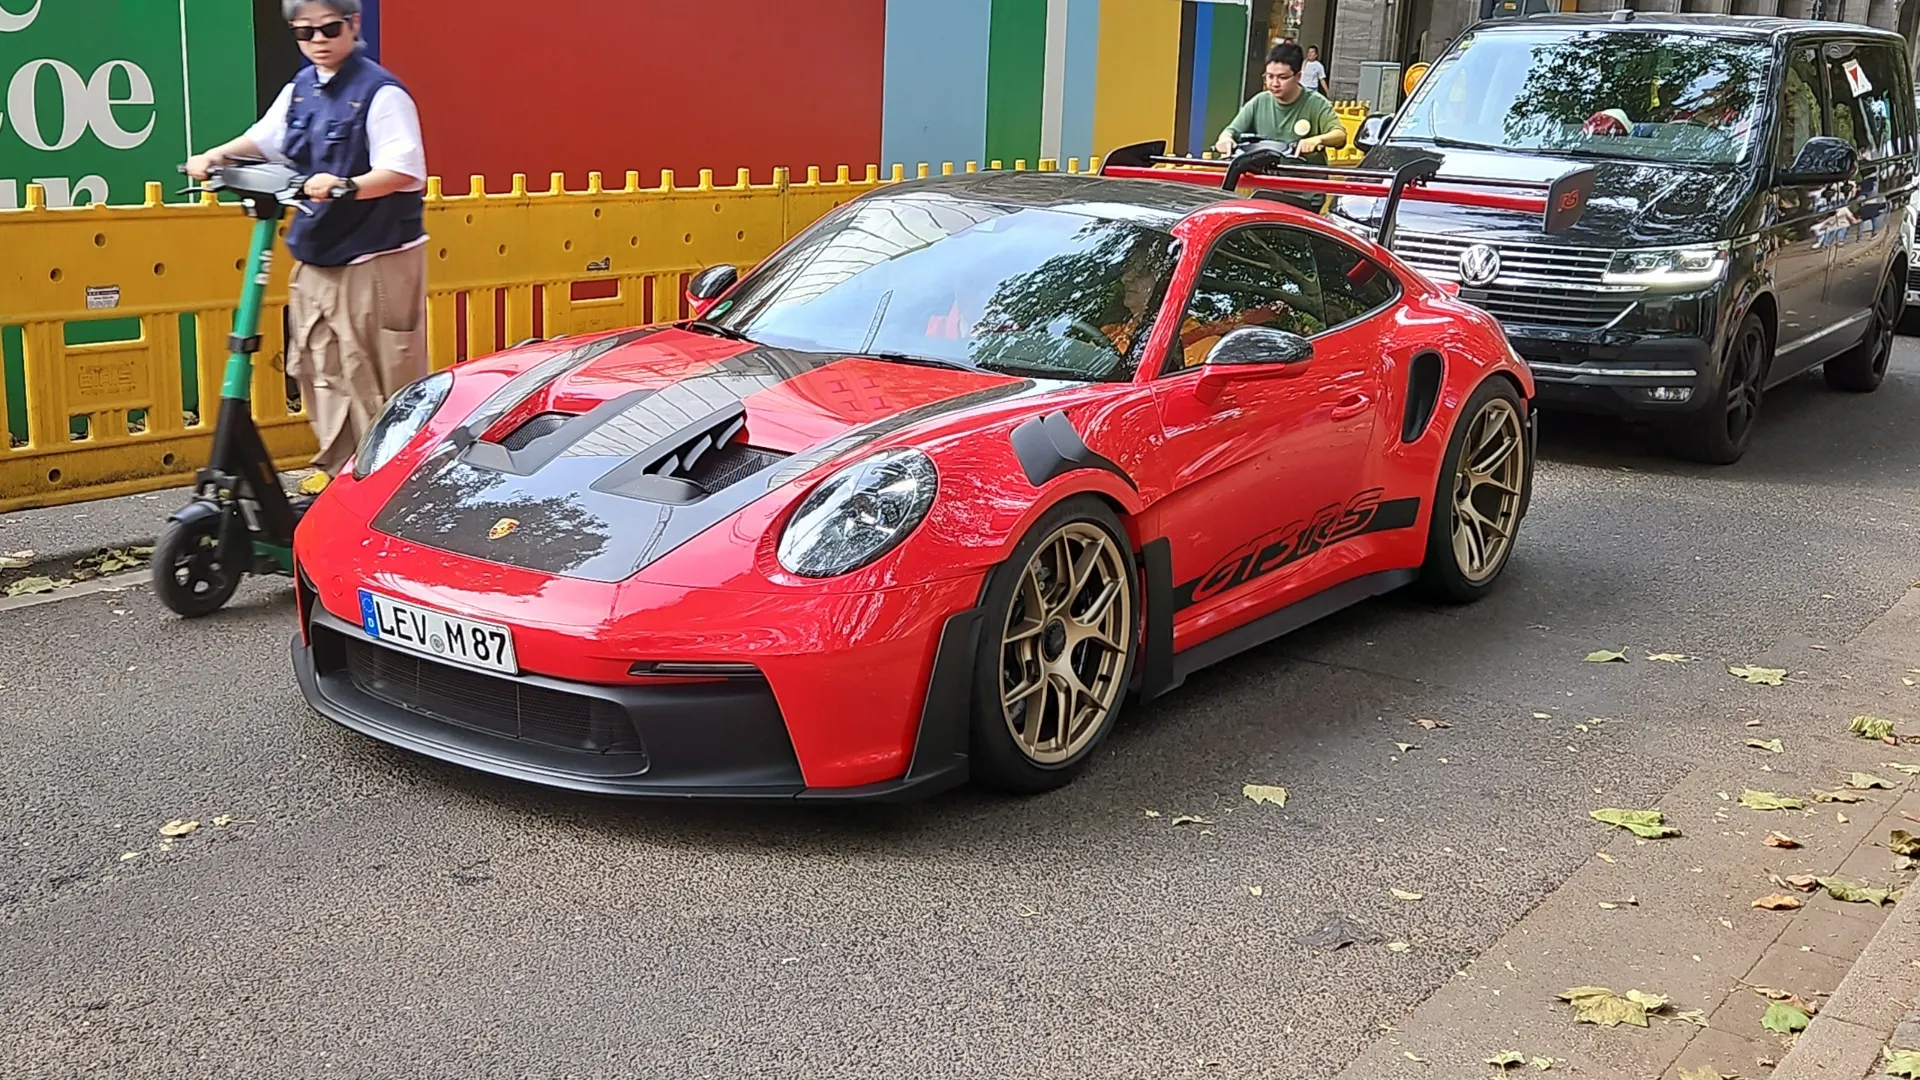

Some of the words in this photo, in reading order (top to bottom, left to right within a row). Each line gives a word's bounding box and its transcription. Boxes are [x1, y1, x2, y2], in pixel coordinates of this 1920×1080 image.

[0, 58, 156, 152] oe
[375, 601, 427, 645] LEV
[444, 620, 467, 657] M
[471, 627, 506, 665] 87
